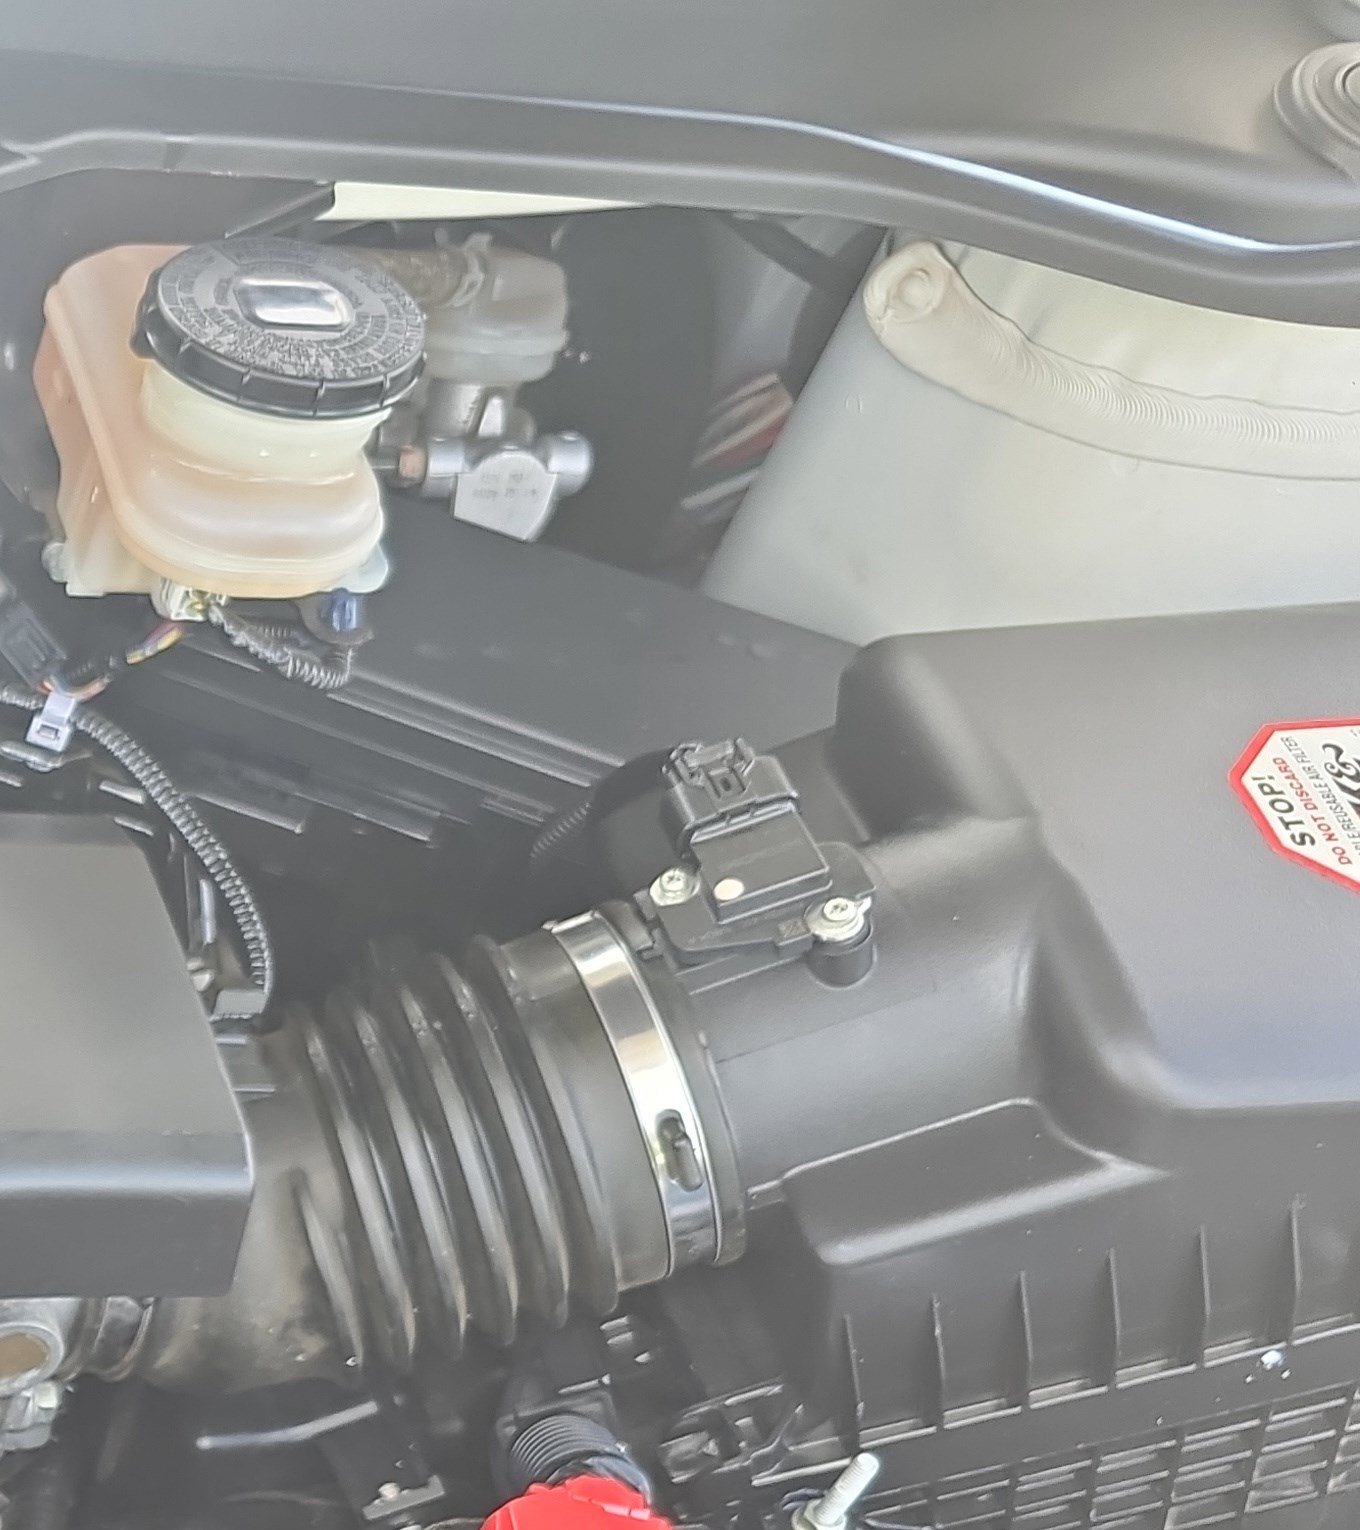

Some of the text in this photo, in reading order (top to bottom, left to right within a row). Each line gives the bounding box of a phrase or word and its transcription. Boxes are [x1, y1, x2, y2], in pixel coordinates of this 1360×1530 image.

[1273, 757, 1319, 811] DISCARD
[1252, 775, 1316, 847] STOP!
[1311, 815, 1339, 842] NOT
[1332, 847, 1353, 865] DO
